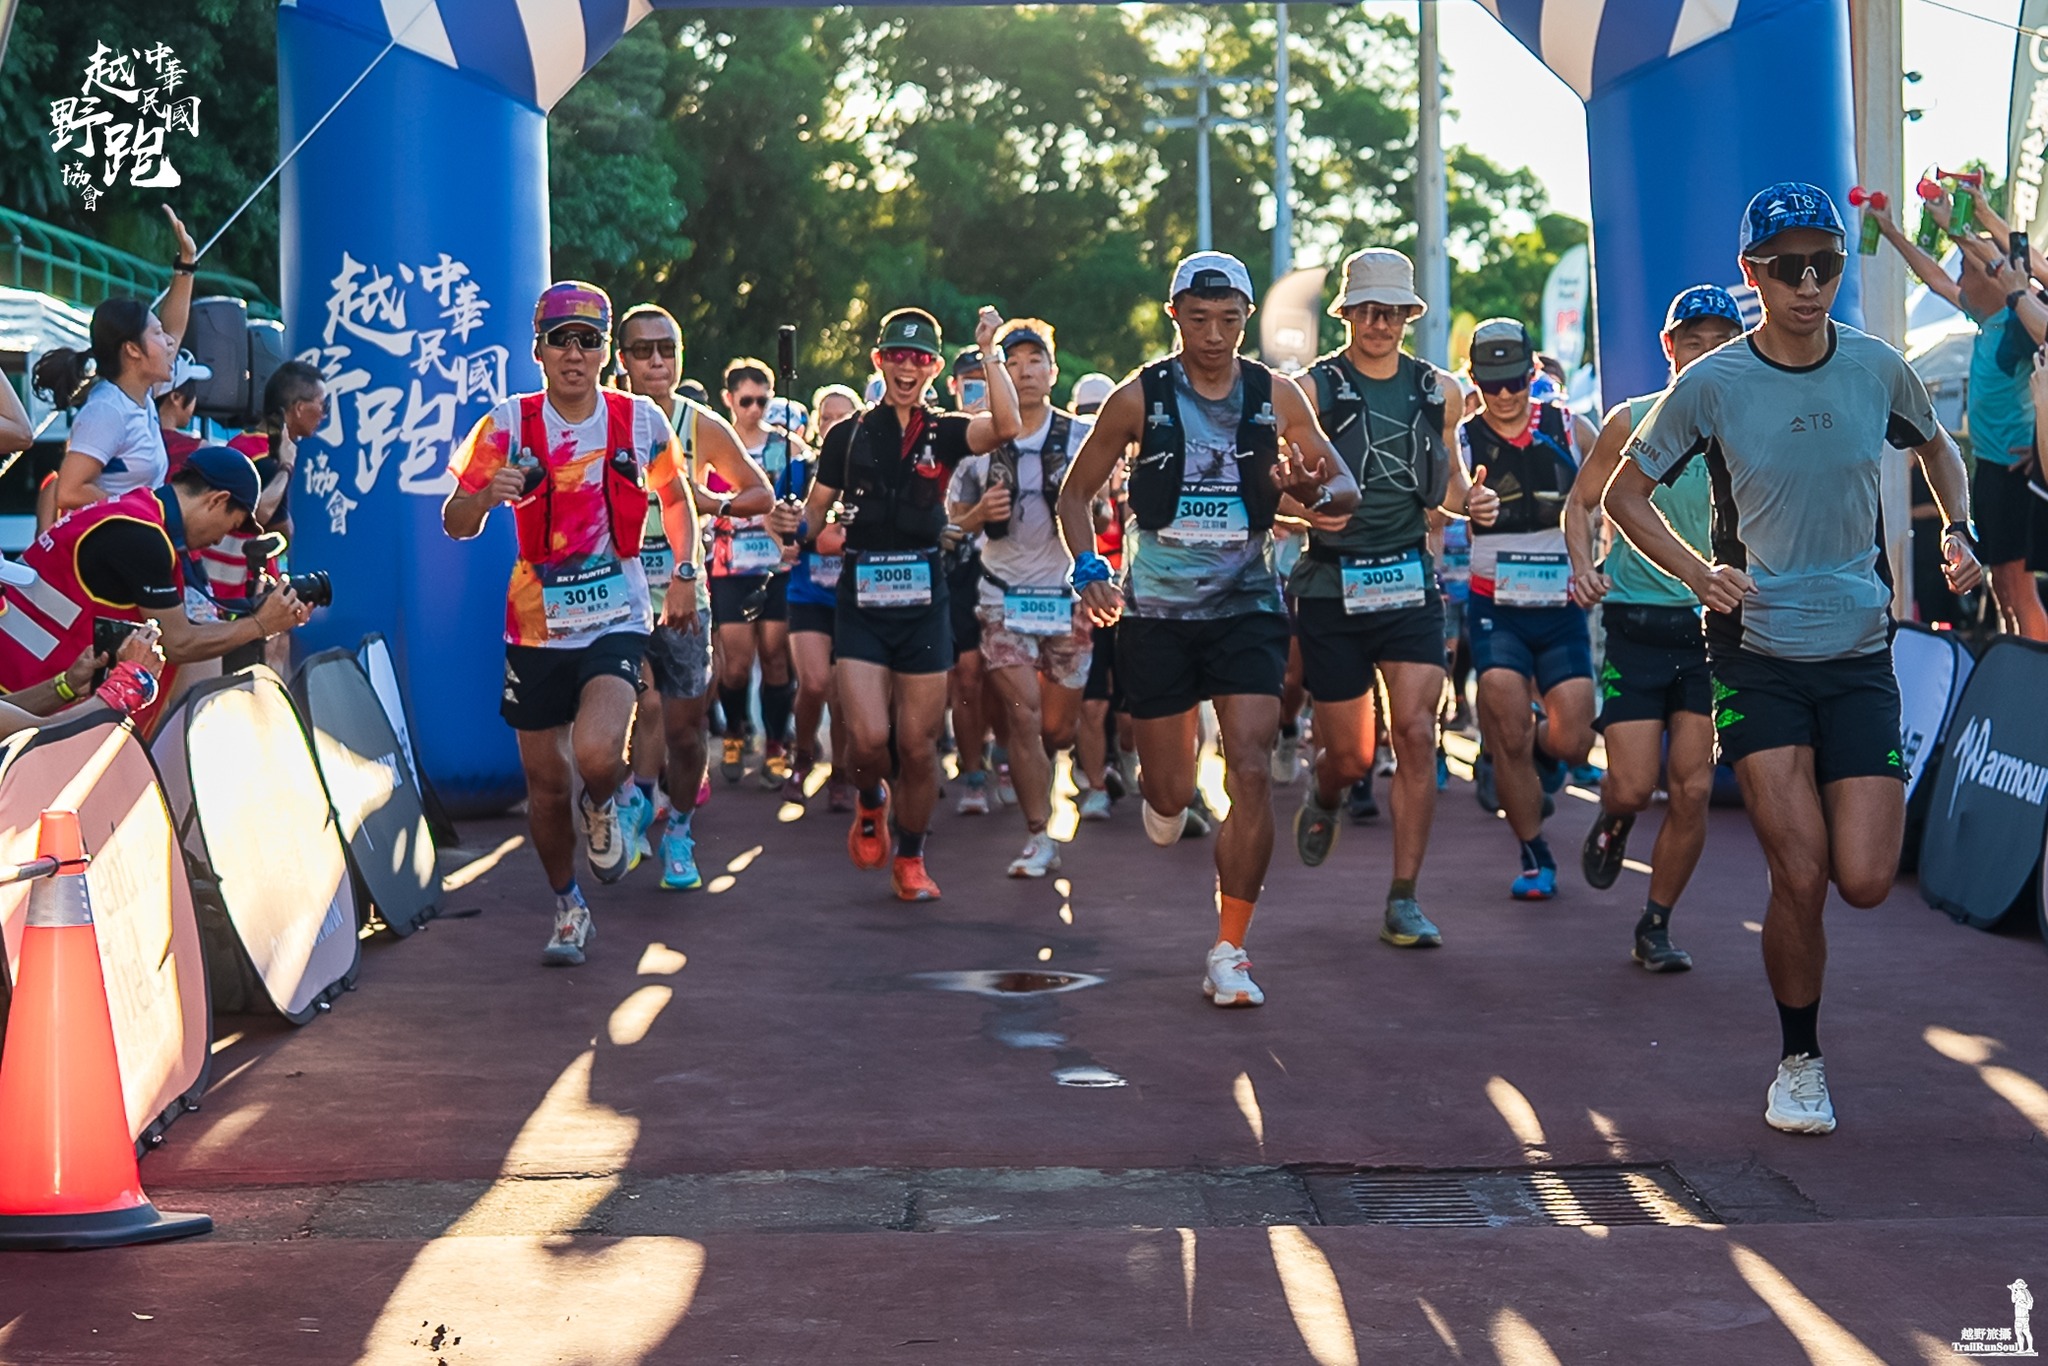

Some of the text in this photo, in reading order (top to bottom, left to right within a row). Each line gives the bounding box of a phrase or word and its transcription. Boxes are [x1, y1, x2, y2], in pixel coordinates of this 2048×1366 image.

[1787, 193, 1816, 210] T8
[1706, 295, 1726, 309] T8
[410, 253, 509, 405] 中華民國
[1807, 412, 1833, 430] T8
[1628, 437, 1662, 463] RUN
[303, 450, 358, 536] 協會
[1181, 501, 1228, 518] 3002
[556, 566, 612, 583] SKY HUNTER
[874, 567, 913, 583] 3008
[1362, 568, 1405, 586] 3003
[563, 583, 609, 606] 3016
[1020, 600, 1056, 613] 3065
